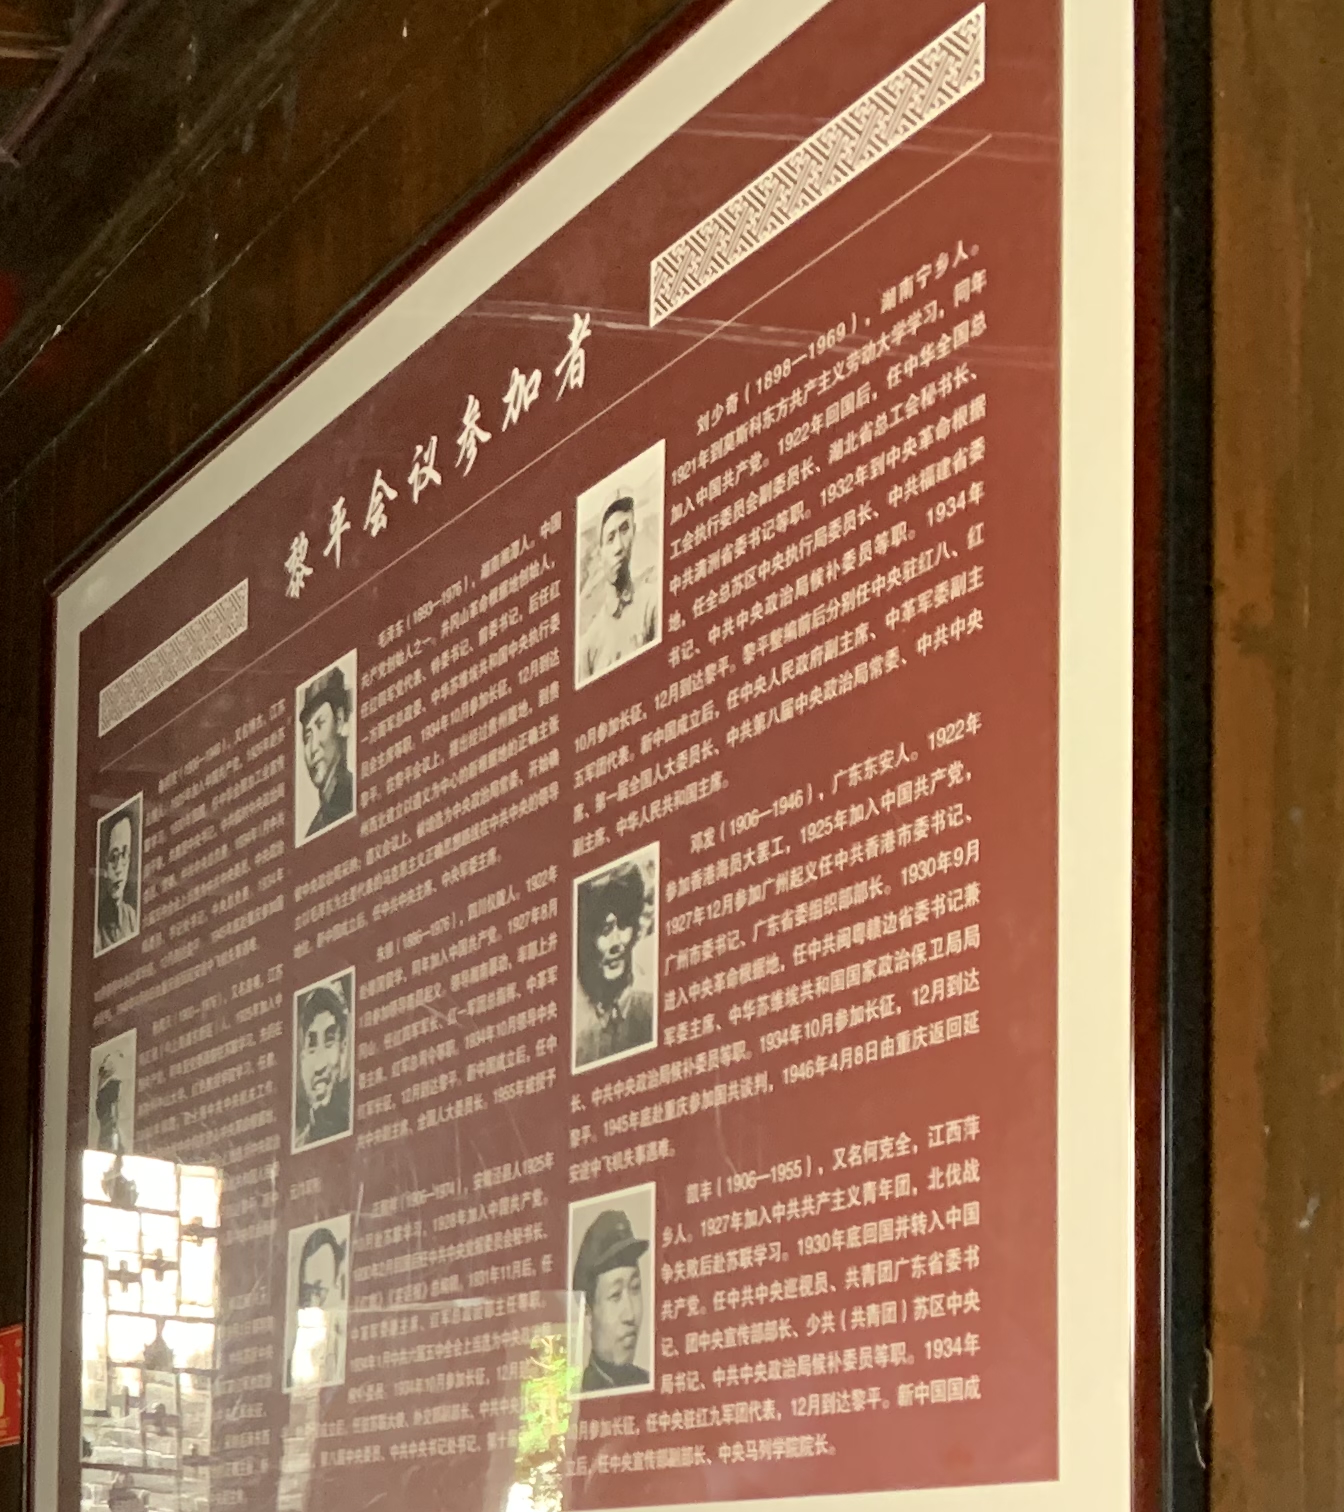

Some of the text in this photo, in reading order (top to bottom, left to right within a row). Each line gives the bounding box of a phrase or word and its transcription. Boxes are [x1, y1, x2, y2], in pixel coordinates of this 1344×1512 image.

[283, 311, 592, 599] 黎平会议参加者
